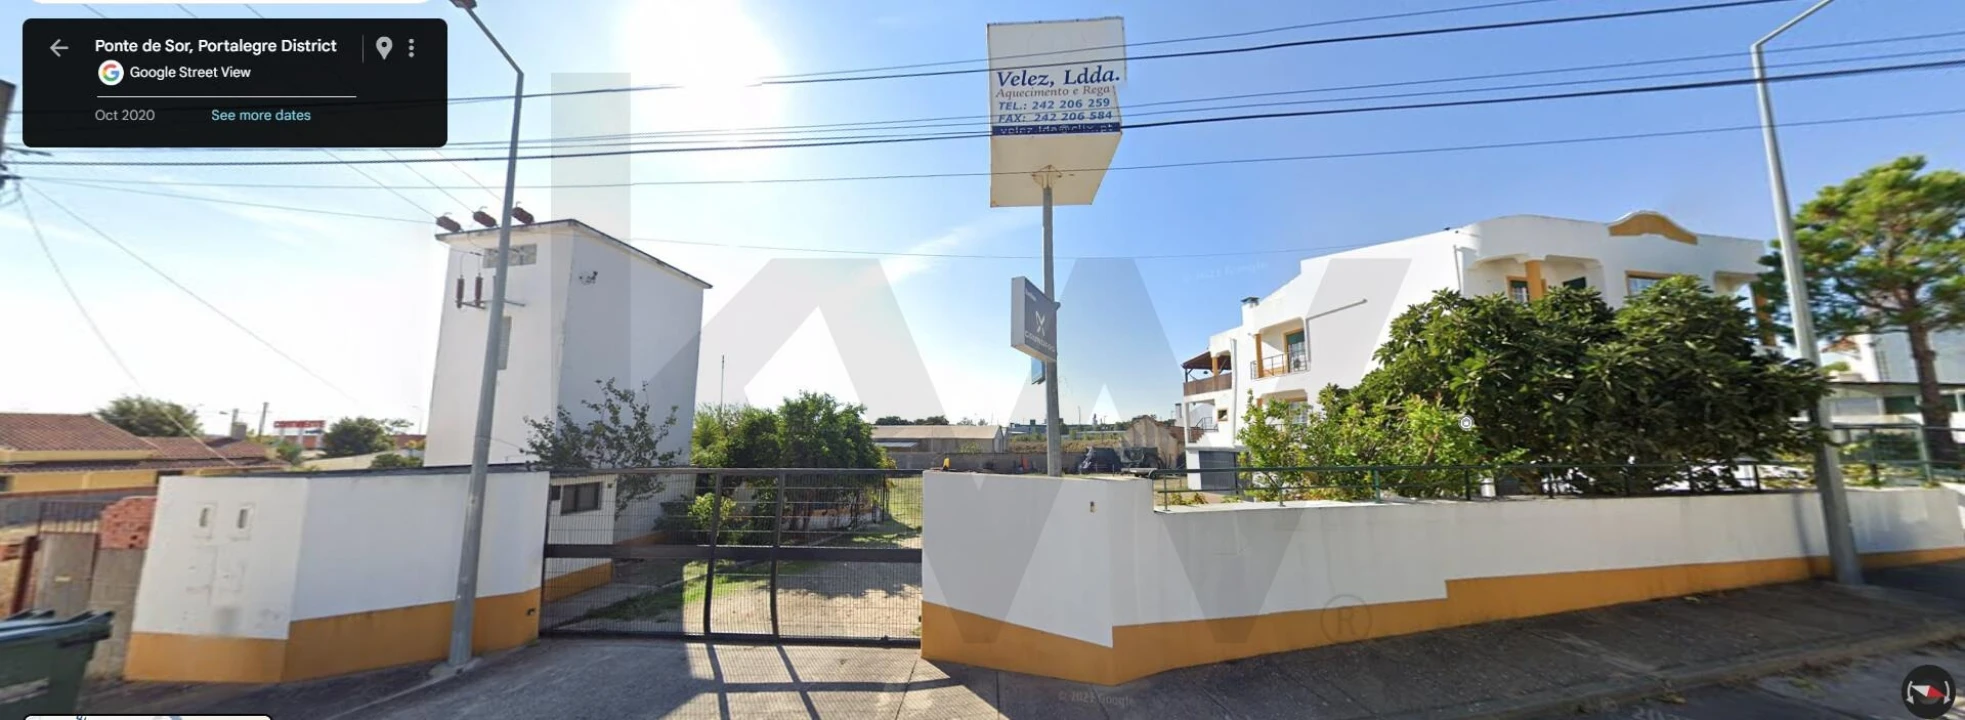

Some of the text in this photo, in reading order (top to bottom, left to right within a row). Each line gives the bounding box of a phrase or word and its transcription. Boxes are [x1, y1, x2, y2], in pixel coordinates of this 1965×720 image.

[997, 65, 1120, 87] Velez, Ldda.
[995, 87, 1069, 100] Aquecimento
[1083, 85, 1110, 97] Rega
[998, 97, 1110, 111] TEL.: 242 206 259
[998, 110, 1112, 123] FAX: 242 206 584
